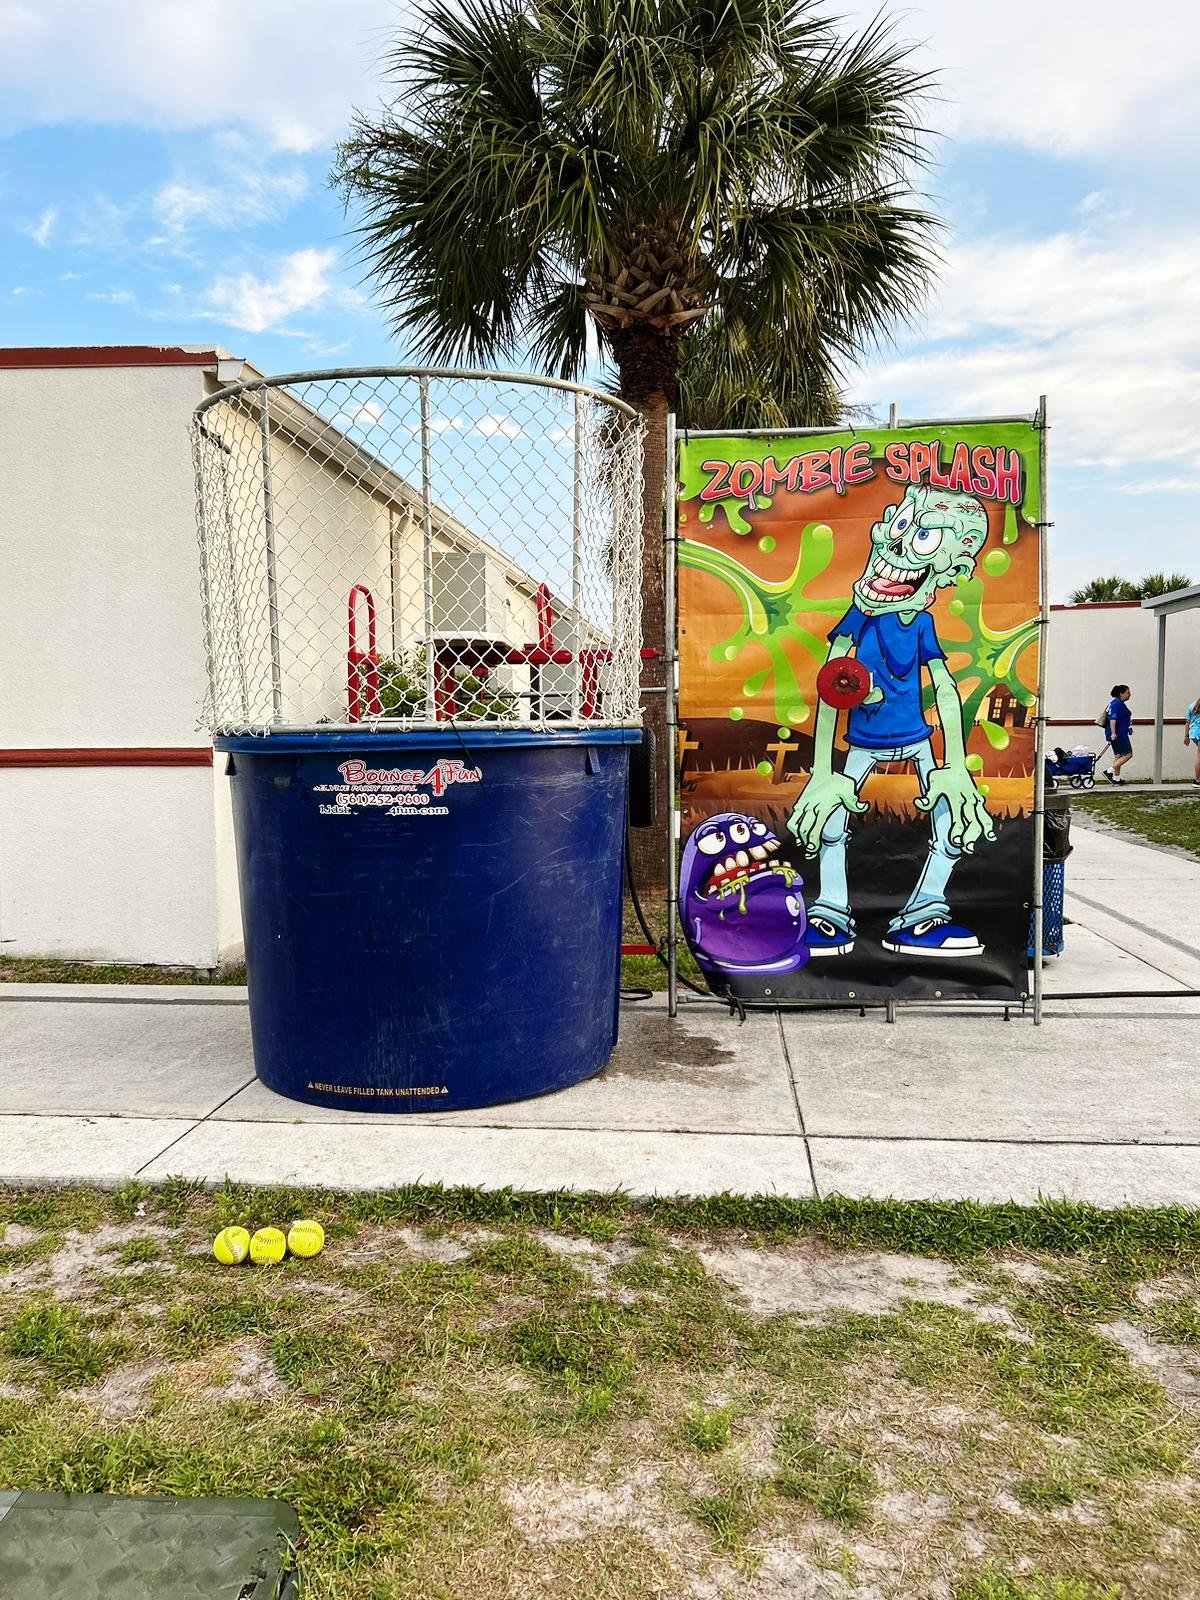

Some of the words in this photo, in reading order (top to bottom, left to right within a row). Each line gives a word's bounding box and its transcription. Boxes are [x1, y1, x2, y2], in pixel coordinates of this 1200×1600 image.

[701, 441, 875, 510] ZOMBIE
[884, 440, 1022, 504] SPLASH
[350, 784, 381, 792] PARTY
[380, 784, 417, 792] RENTAL
[336, 793, 430, 806] (561)252-9600
[314, 1082, 333, 1092] NEVER
[333, 1085, 353, 1095] LEAVE
[353, 1087, 375, 1096] FILLED
[376, 1088, 393, 1096] TANK
[395, 1086, 440, 1096] UNATTENDED
